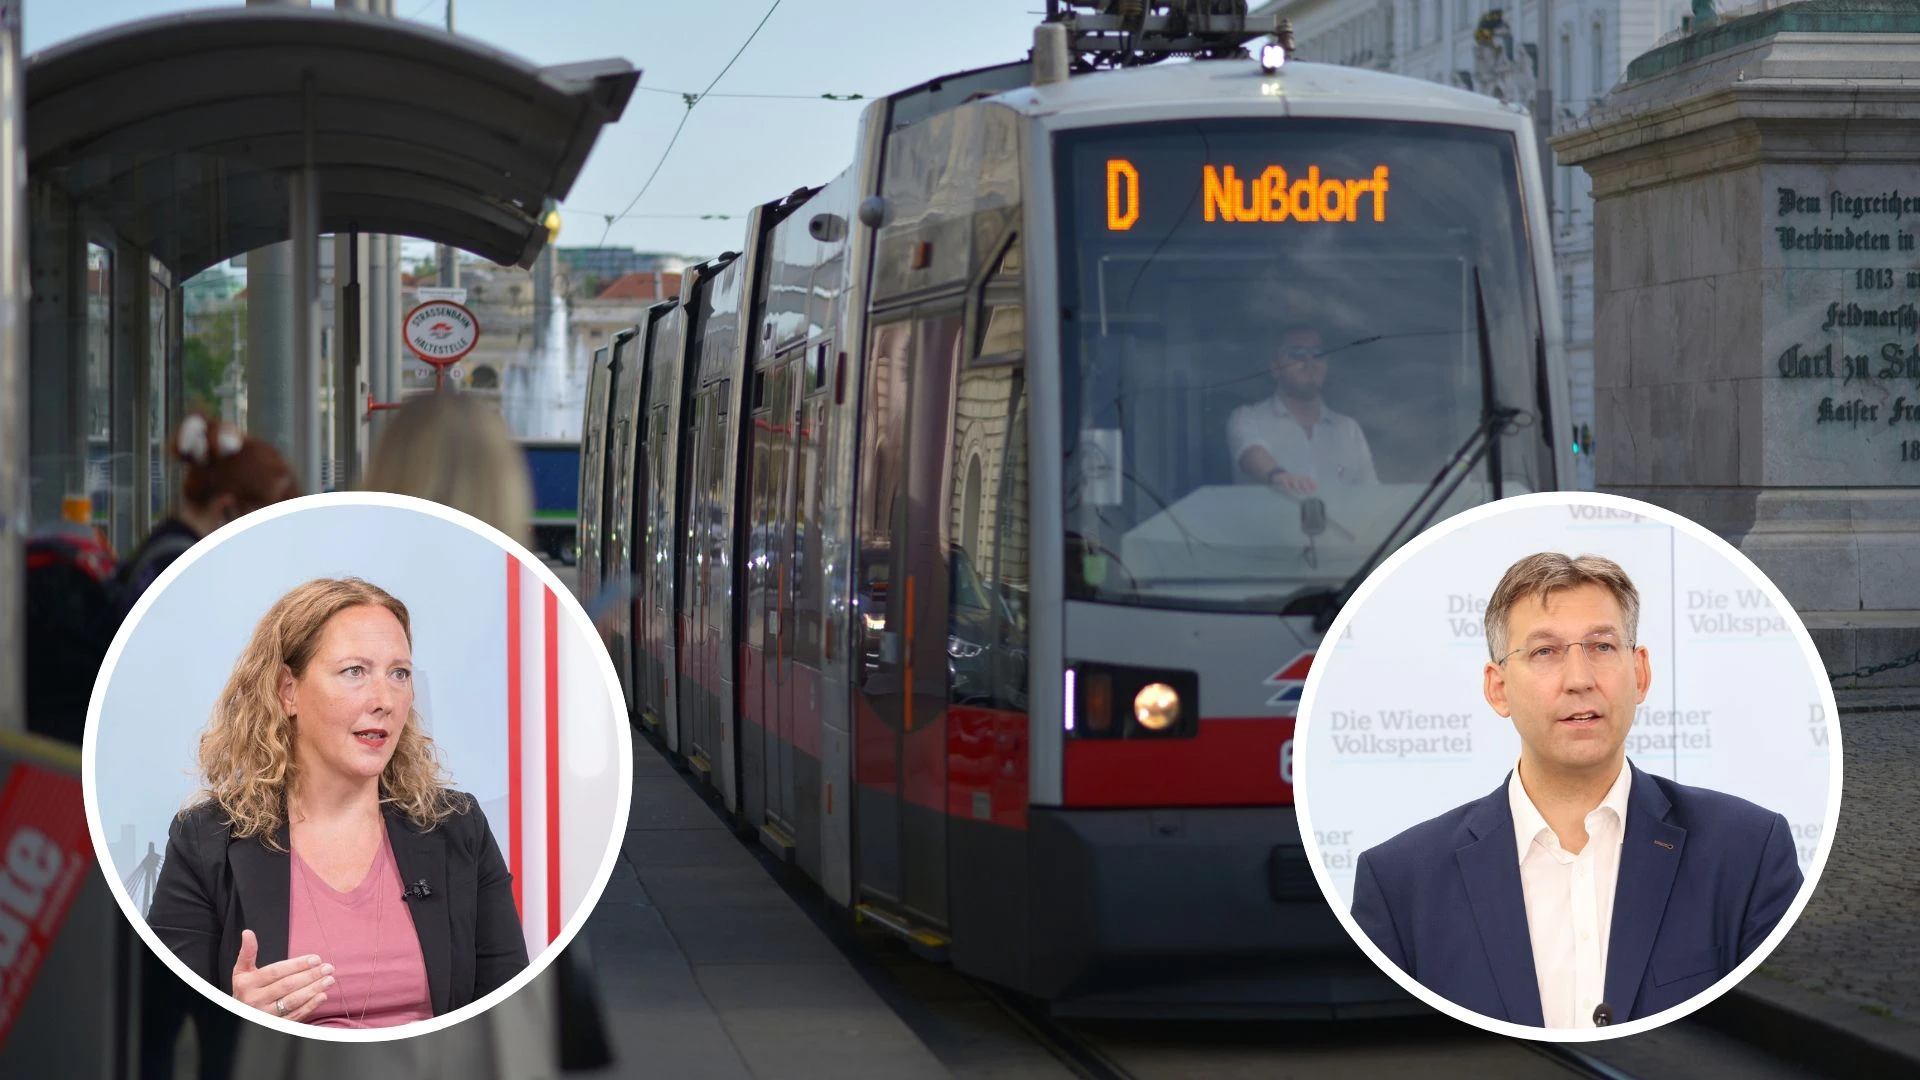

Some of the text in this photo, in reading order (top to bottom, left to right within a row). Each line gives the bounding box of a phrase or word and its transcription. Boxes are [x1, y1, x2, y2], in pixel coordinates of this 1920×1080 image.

[1107, 159, 1390, 231] D Nußdorf
[1777, 187, 1821, 216] Dem
[1775, 226, 1915, 251] Verbündeten in
[1855, 268, 1894, 290] 1813
[412, 307, 470, 328] STRASSENBAHN
[414, 336, 468, 354] HALTESTELLE
[1778, 343, 1834, 379] Carl
[1843, 354, 1870, 387] zu
[1447, 592, 1488, 613] Die
[1688, 588, 1776, 609] Die Wi
[1688, 612, 1792, 637] Volkspa
[1331, 709, 1473, 731] Die Wiener
[1331, 732, 1473, 758] Volkspartei
[1808, 727, 1829, 747] V
